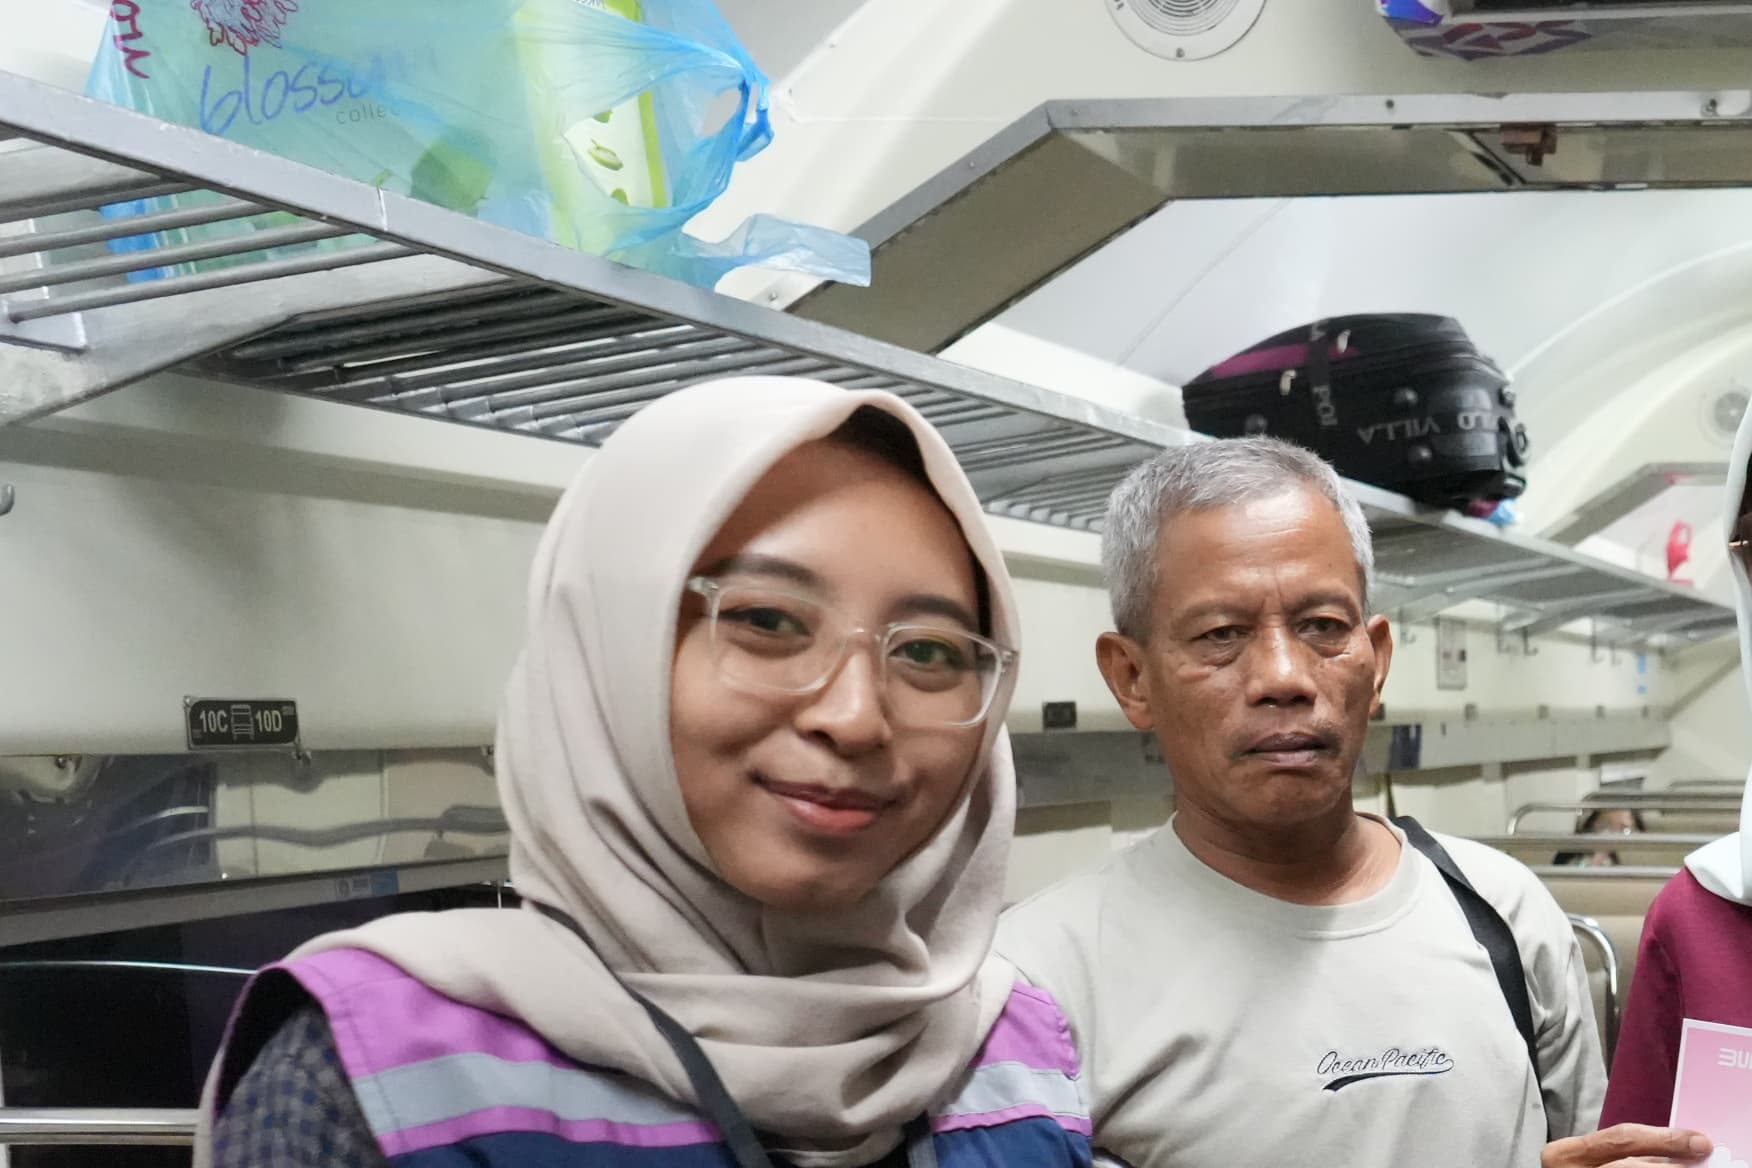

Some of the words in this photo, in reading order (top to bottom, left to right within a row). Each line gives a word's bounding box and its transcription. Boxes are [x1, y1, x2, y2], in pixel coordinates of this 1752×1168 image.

[199, 709, 229, 733] 10C
[255, 709, 282, 733] 10D
[1316, 1050, 1379, 1075] Ocean
[1382, 1048, 1447, 1070] Pacific
